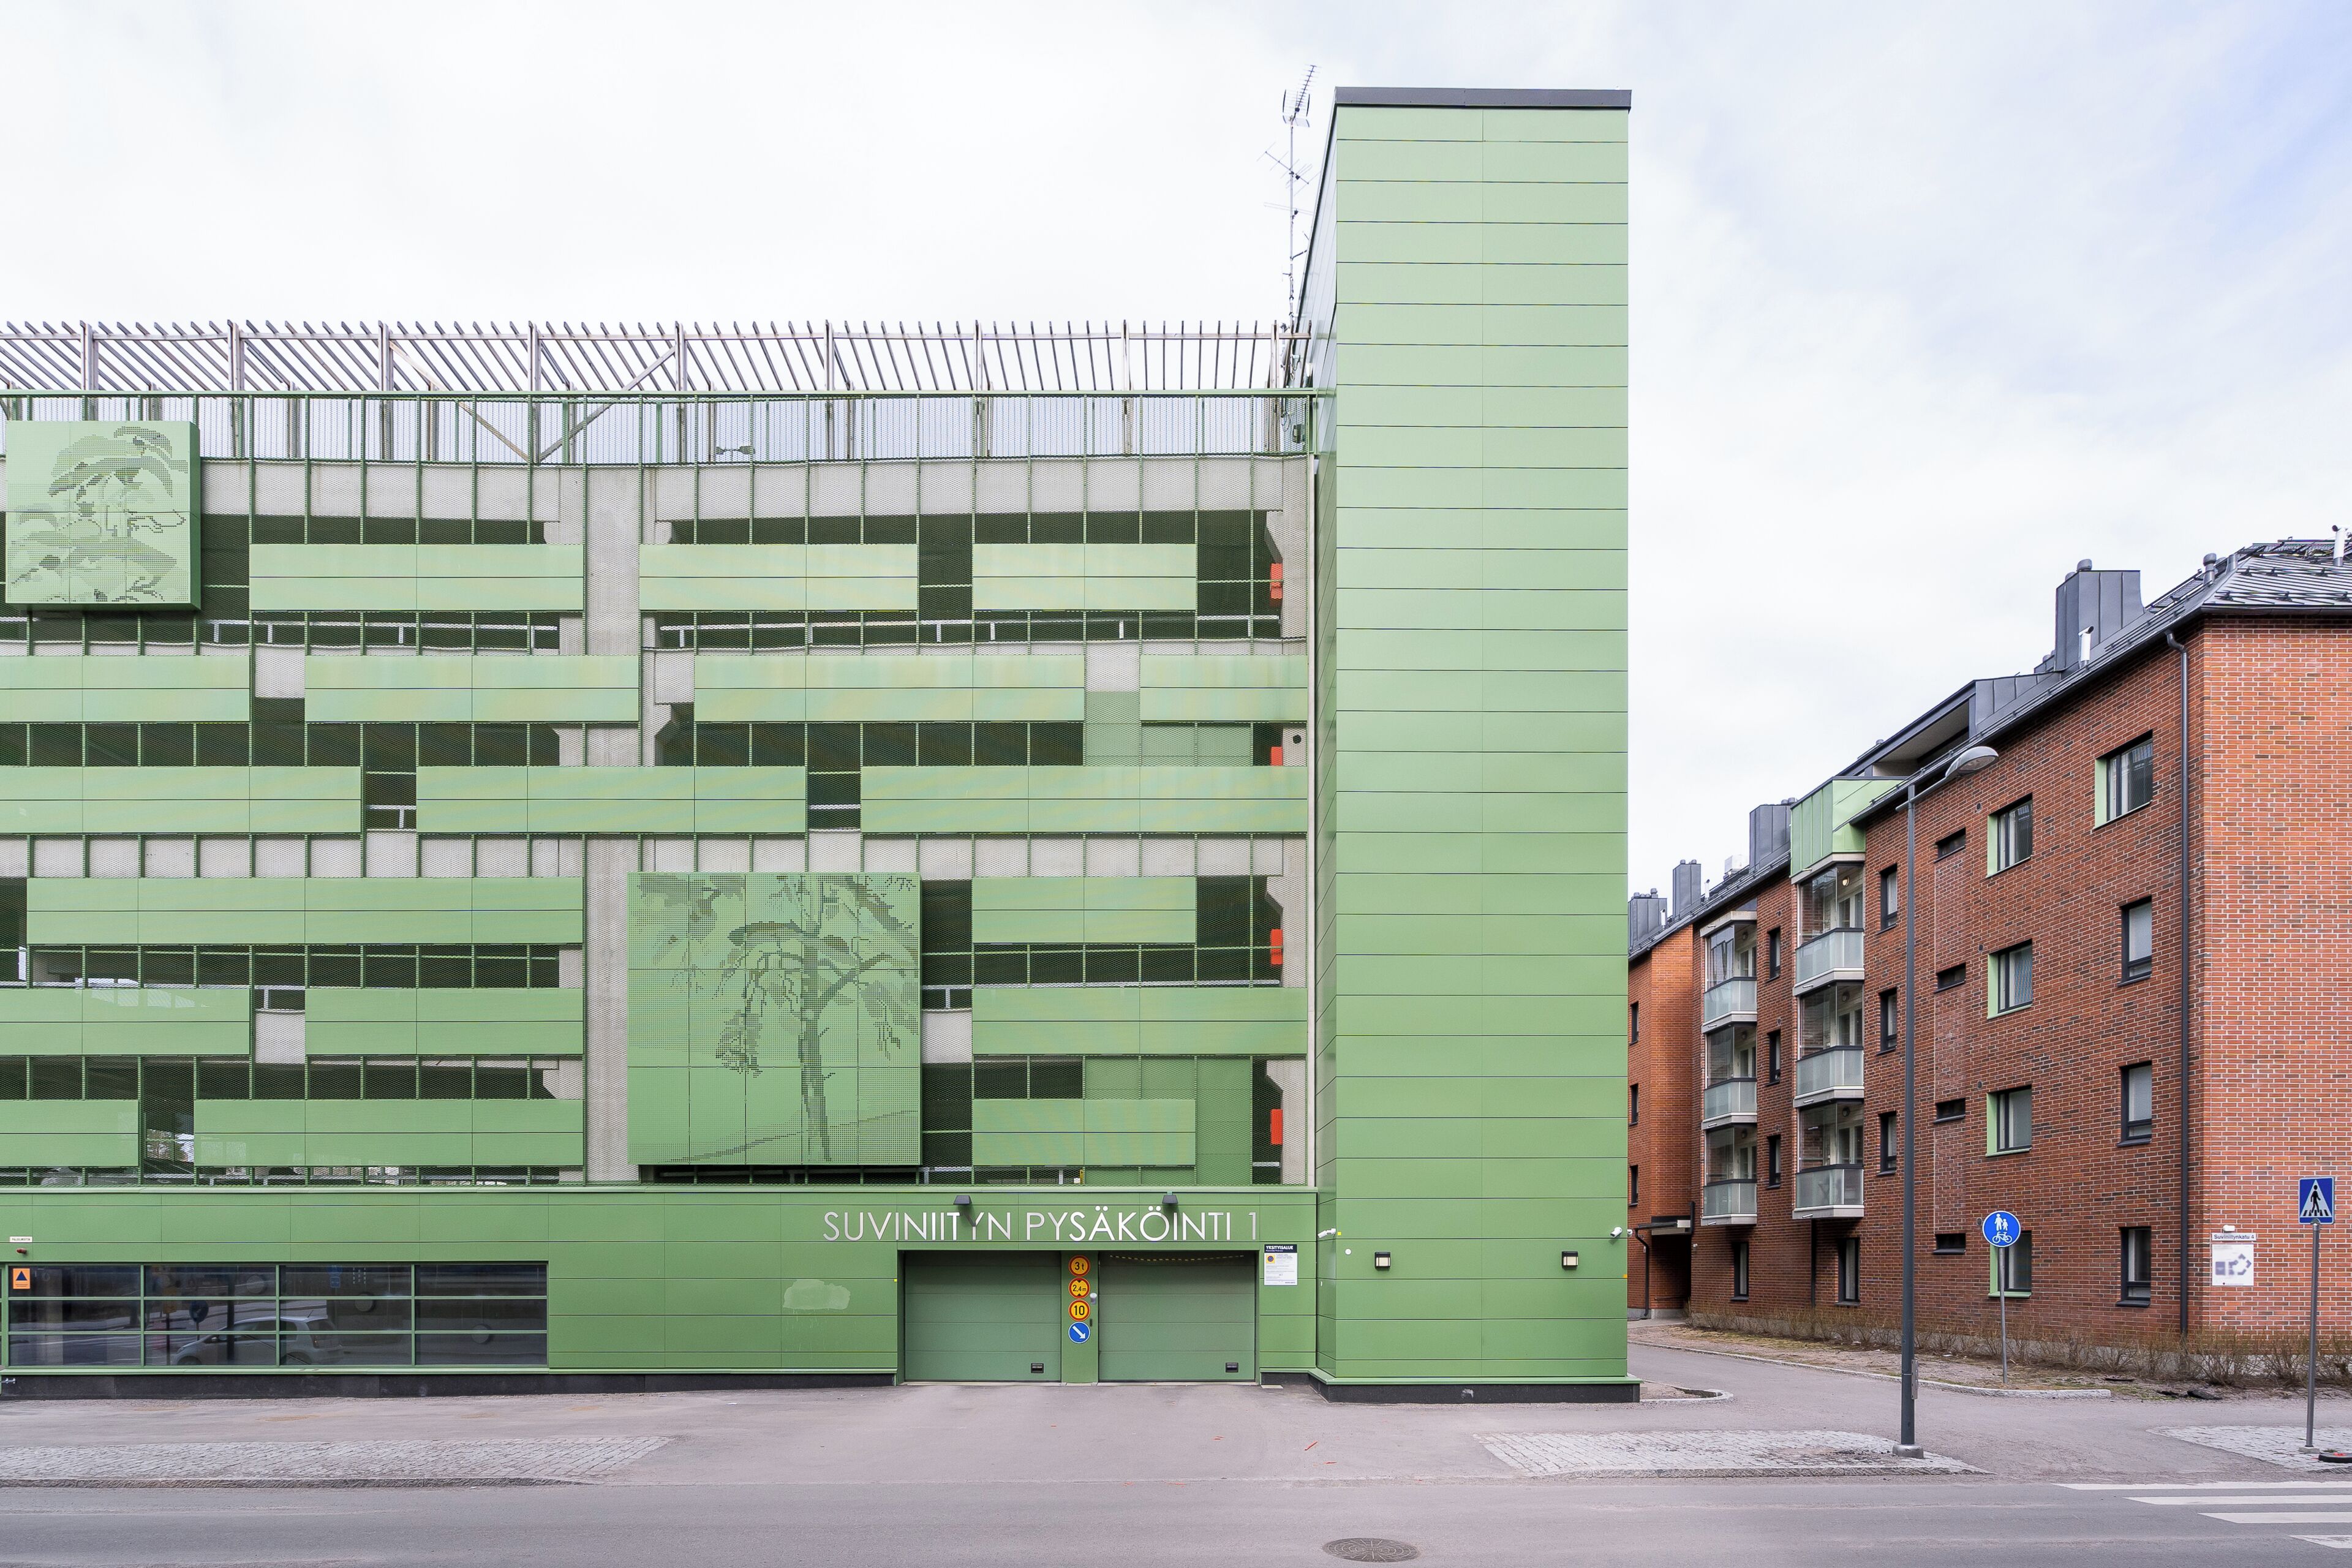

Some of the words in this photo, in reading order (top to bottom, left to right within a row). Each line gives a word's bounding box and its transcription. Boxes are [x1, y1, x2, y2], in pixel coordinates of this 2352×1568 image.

[823, 1212, 1011, 1241] SUVINIITYN
[1026, 1205, 1231, 1241] PYSÄKÖINTI
[1248, 1212, 1257, 1240] 1
[1075, 1262, 1080, 1270] 3
[1074, 1305, 1085, 1316] 10
